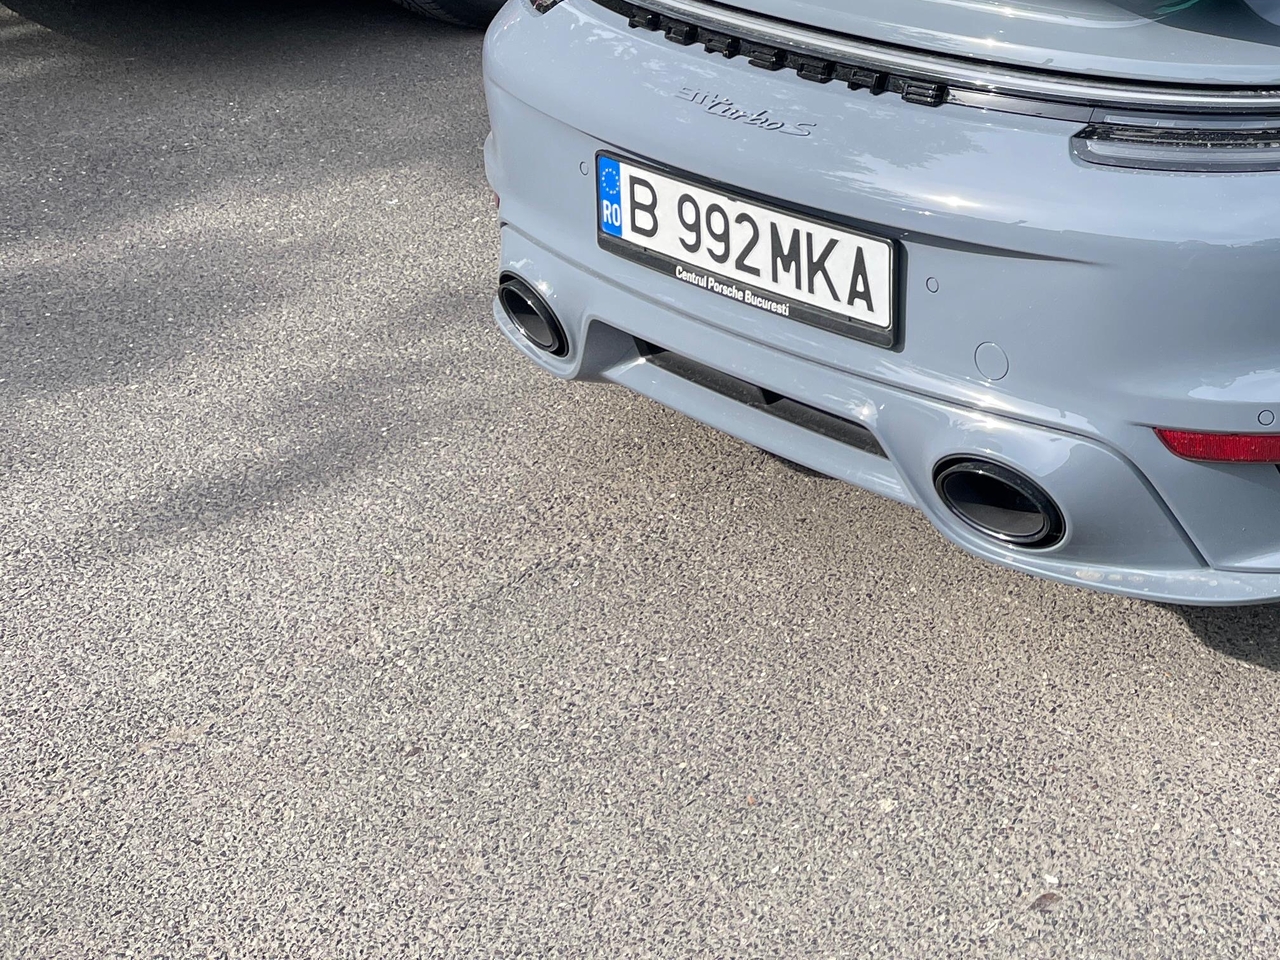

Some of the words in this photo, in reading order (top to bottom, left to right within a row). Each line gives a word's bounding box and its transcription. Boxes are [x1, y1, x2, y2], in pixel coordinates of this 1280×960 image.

[602, 199, 621, 227] RO
[629, 174, 659, 239] B
[675, 265, 707, 289] Centrul
[707, 276, 744, 301] Porsche
[744, 289, 790, 316] Bucuresti
